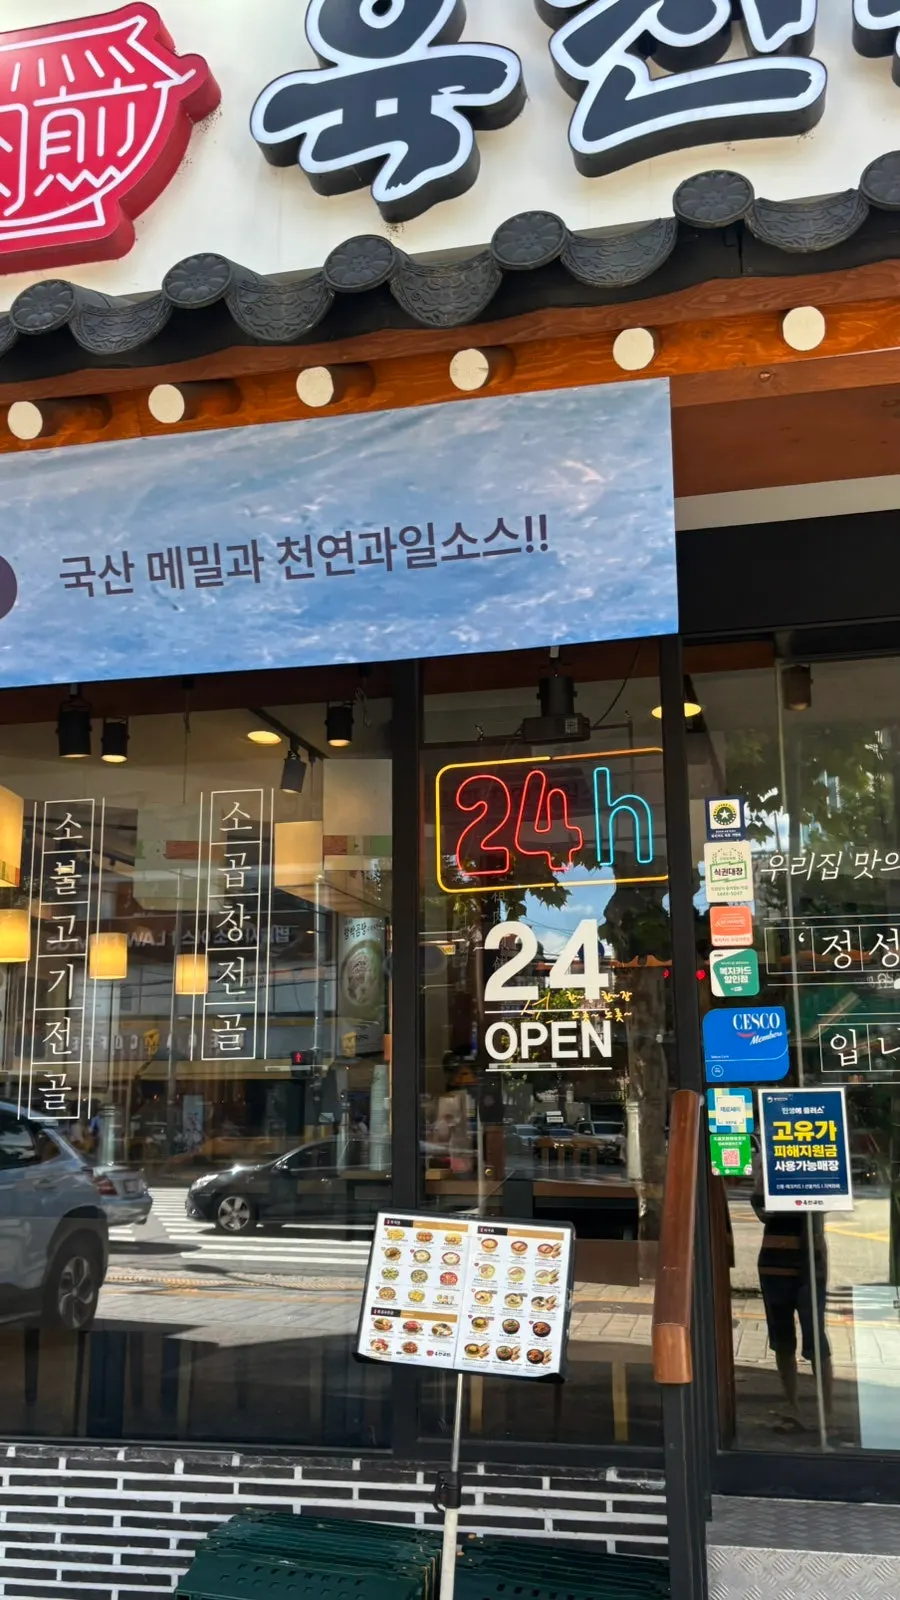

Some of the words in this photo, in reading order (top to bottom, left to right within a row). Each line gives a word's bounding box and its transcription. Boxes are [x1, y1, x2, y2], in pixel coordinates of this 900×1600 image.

[59, 549, 135, 598] 국산
[147, 539, 265, 591] 메밀과
[276, 513, 548, 582] 천연과일소스!!
[455, 766, 654, 876] 24h
[713, 867, 743, 877] 식권대장
[760, 850, 843, 882] 우리집
[211, 802, 254, 1052] 소곱창전골
[38, 812, 84, 1111] 소불고기전골
[484, 918, 609, 1002] 24
[732, 1012, 780, 1030] CESCO
[484, 1020, 613, 1060] OPEN
[749, 1029, 783, 1046] Members
[772, 1120, 838, 1142] 고유가
[773, 1144, 838, 1158] 피해지원금
[774, 1159, 839, 1172] 사용가능매장
